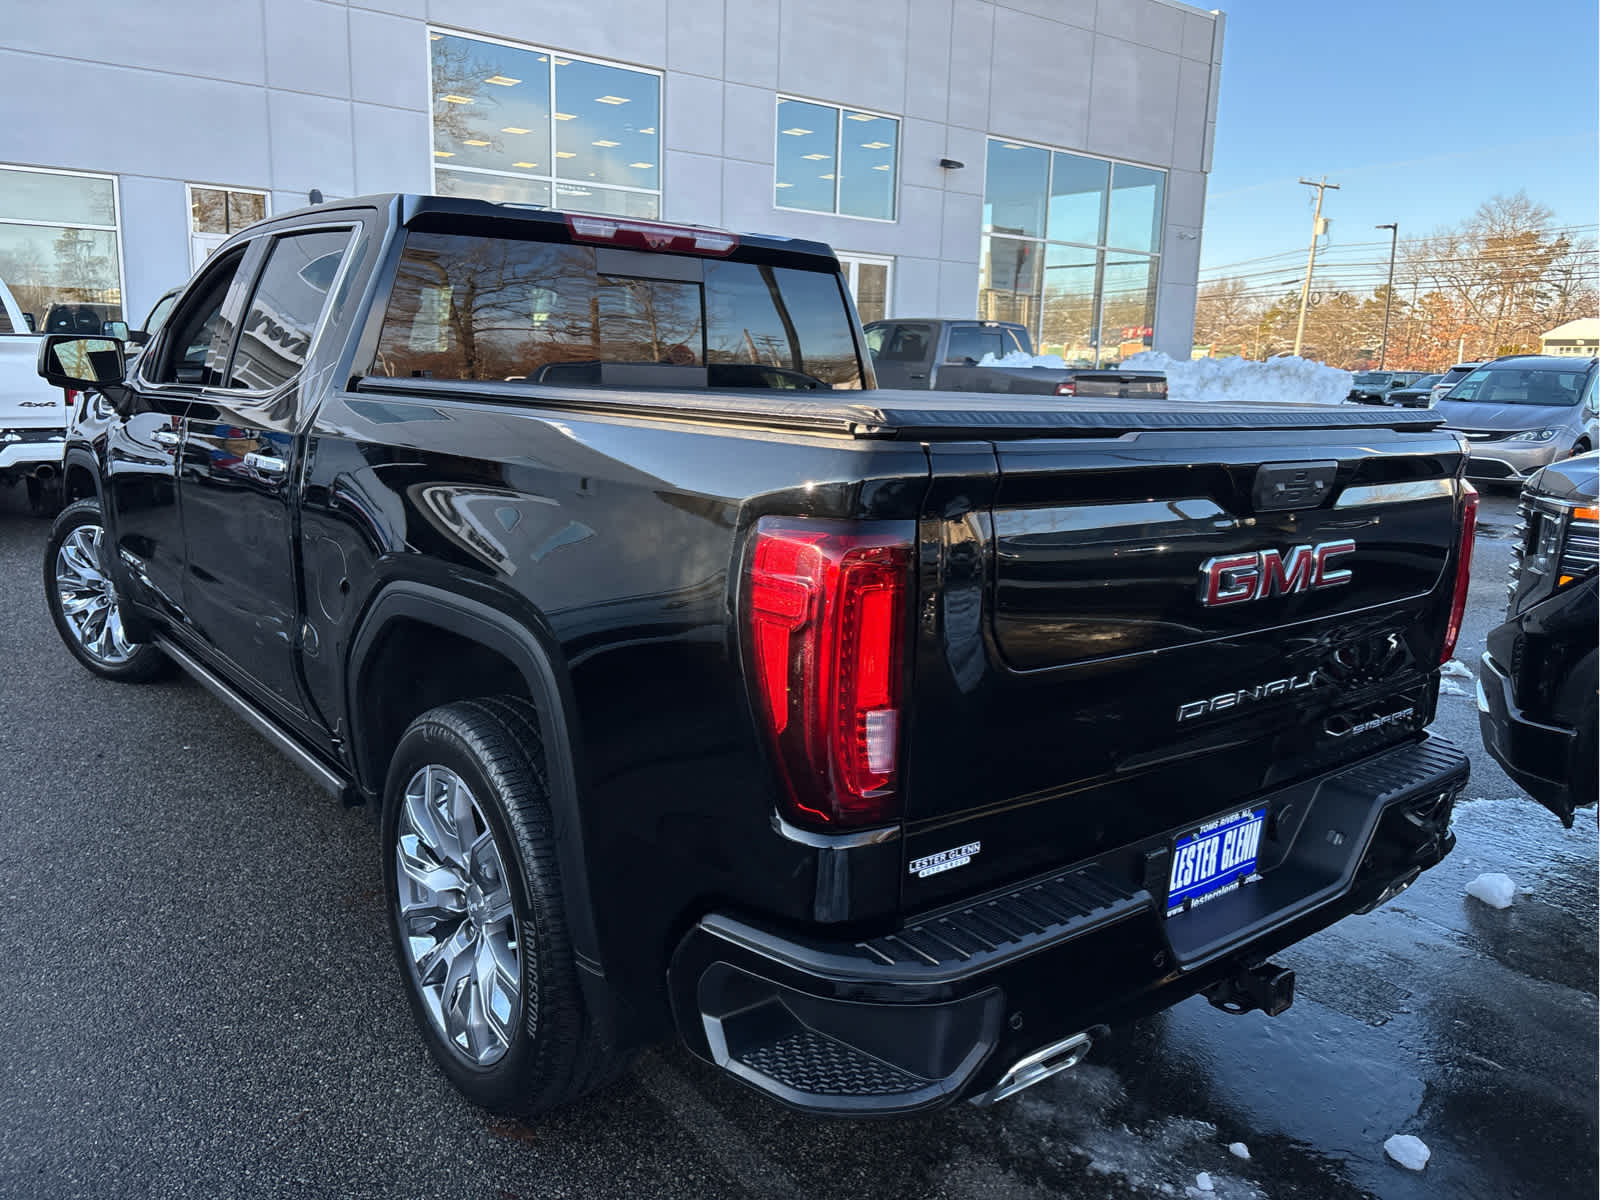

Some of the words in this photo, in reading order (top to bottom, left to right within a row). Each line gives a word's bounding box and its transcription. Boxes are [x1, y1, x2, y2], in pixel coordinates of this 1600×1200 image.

[1199, 539, 1356, 607] GMC
[1177, 671, 1319, 721] DENALI
[1200, 821, 1219, 834] TOMS
[909, 853, 946, 872] LESTER
[948, 843, 980, 859] GLENN
[1169, 836, 1220, 891] LESTER
[1221, 820, 1261, 871] GLENN
